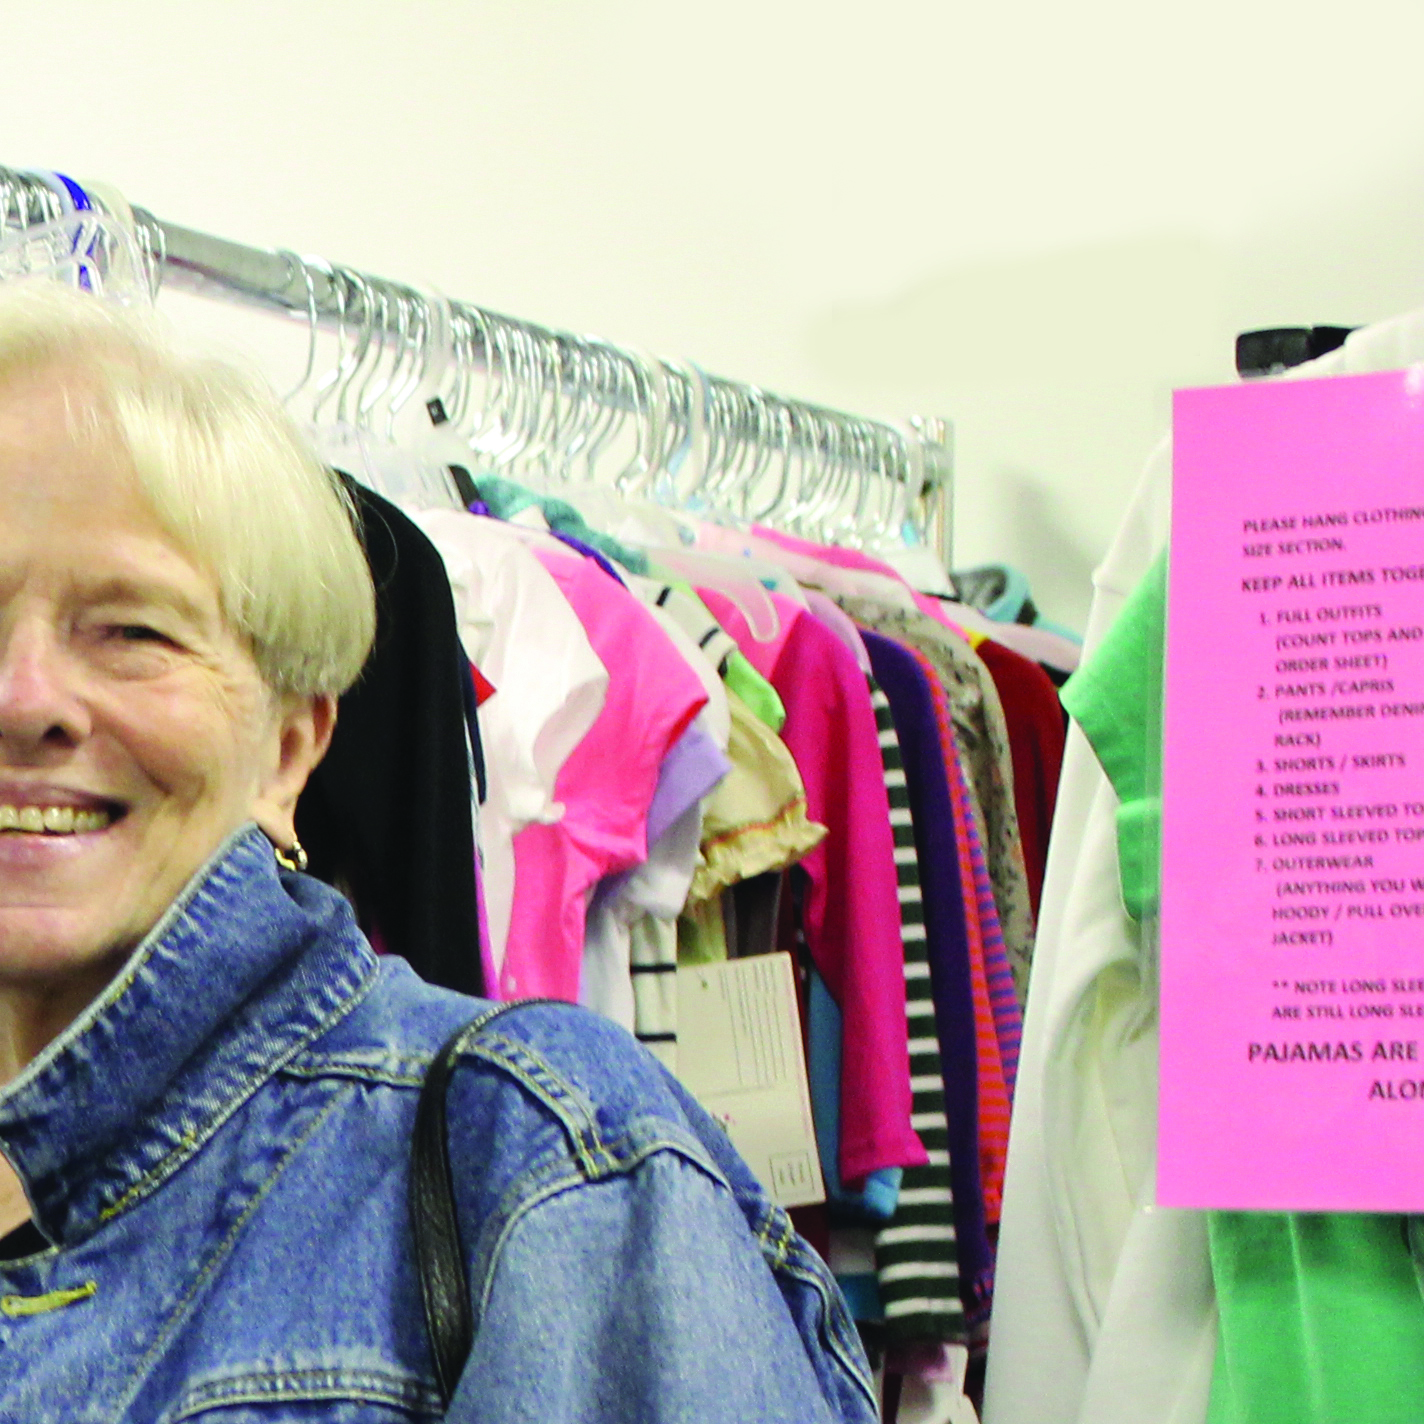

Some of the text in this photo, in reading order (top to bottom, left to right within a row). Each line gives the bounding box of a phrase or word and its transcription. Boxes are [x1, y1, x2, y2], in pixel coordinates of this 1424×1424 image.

[1243, 515, 1297, 533] PLEASE
[1302, 511, 1349, 529] HANG
[1243, 543, 1273, 558] SIZE
[1241, 575, 1283, 592] KEEP
[1288, 572, 1315, 590] ALL
[1322, 568, 1375, 587] ITEMS
[1277, 608, 1312, 624] FULL
[1317, 603, 1383, 622] OUTFITS
[1276, 625, 1424, 652] (COUNT TOPS AND
[1275, 653, 1389, 674] ORDER SHEET)
[1275, 681, 1327, 700] PANTS
[1279, 705, 1376, 727] (REMEMBER
[1274, 731, 1322, 750] RACK)
[1273, 755, 1336, 772] SHORTS
[1352, 752, 1406, 769] SKIRTS
[1273, 781, 1340, 798] DRESSES
[1273, 805, 1325, 822] SHORT
[1331, 802, 1398, 820] SLEEVED
[1273, 830, 1317, 847] LONG
[1321, 828, 1390, 844] SLEEVED
[1272, 855, 1374, 872] OUTERWEAR
[1277, 880, 1366, 898] (ANYTHING
[1371, 878, 1405, 894] YOU
[1272, 904, 1329, 921] HOODY
[1347, 903, 1385, 919] PULL
[1273, 929, 1333, 946] JACKET)
[1294, 979, 1337, 995] NOTE
[1342, 978, 1387, 995] LONG
[1272, 1005, 1301, 1020] ARE
[1306, 1004, 1345, 1020] STILL
[1349, 1003, 1394, 1019] LONG
[1248, 1040, 1418, 1064] PAJAMAS ARE
